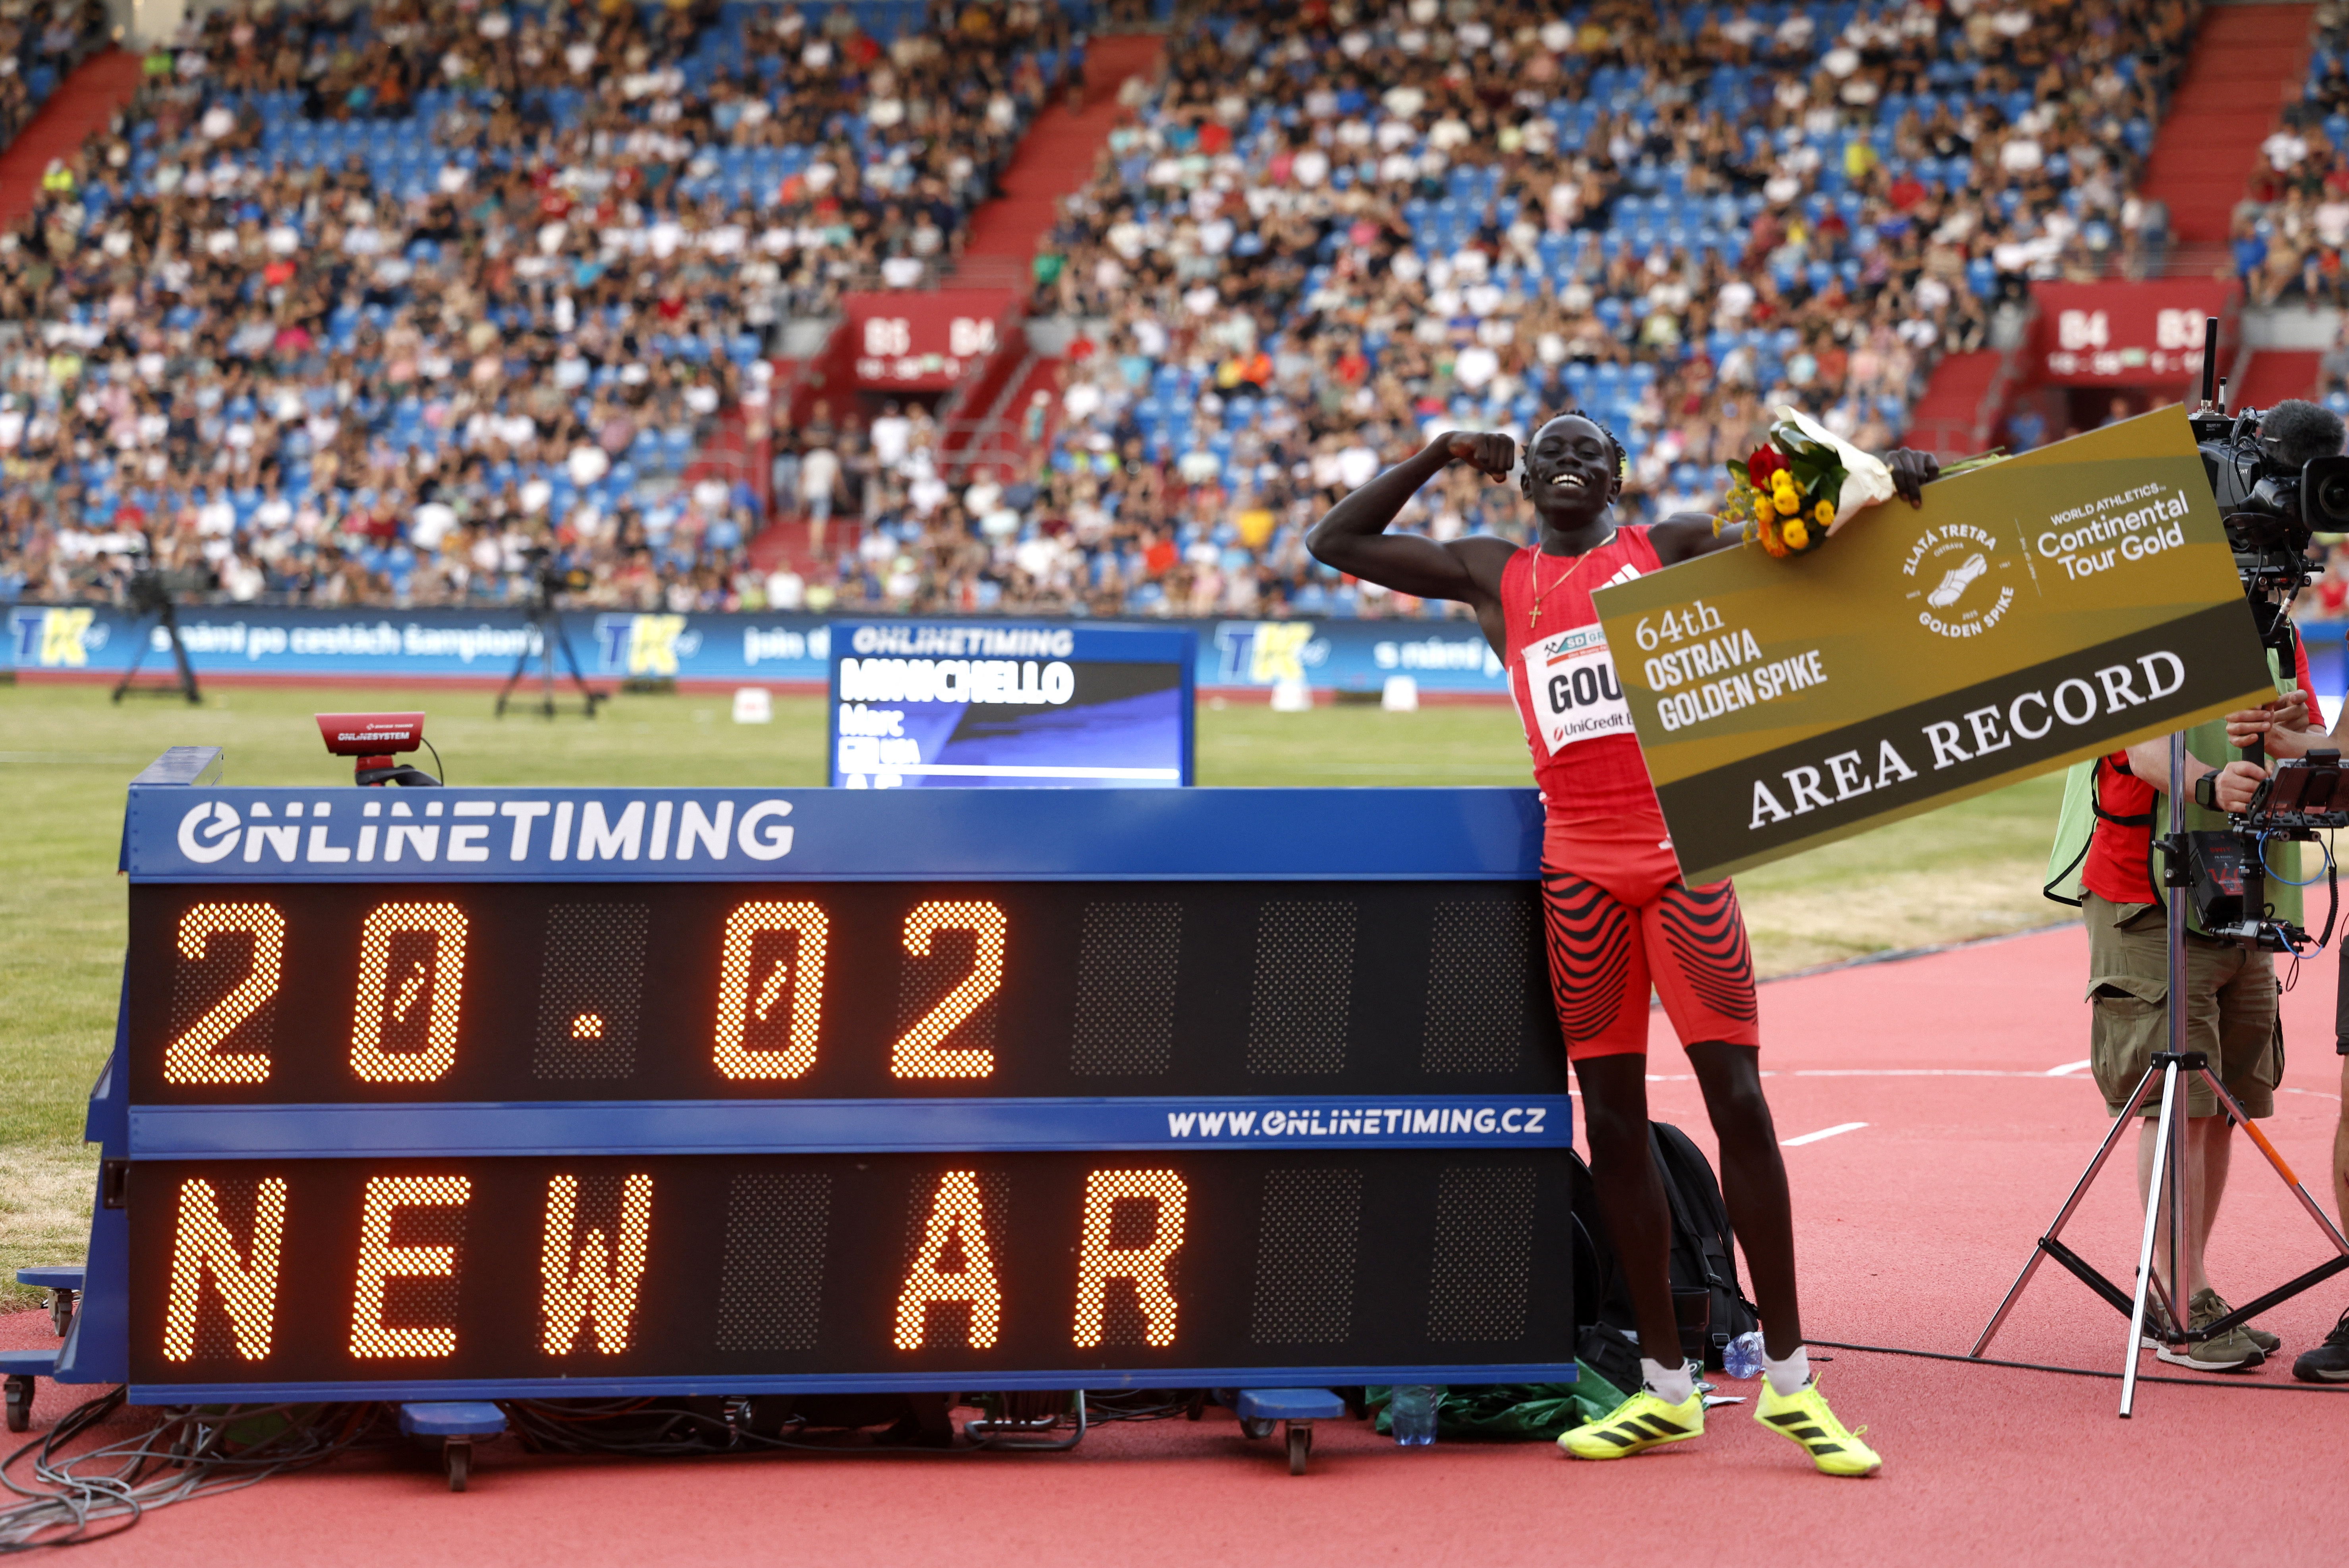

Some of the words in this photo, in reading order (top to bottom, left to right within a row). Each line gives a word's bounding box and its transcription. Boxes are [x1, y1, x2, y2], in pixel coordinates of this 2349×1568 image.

[2038, 489, 2189, 558] Continental
[2050, 504, 2094, 526] WORLD
[2096, 483, 2159, 512] ATHLETICS
[1903, 529, 1939, 576] ZLATÁ
[1939, 524, 1996, 551] TRETRA
[1934, 542, 1964, 557] OSTRAVA
[2057, 548, 2116, 580] Tour
[2121, 521, 2184, 561] Gold
[1636, 600, 1725, 651] 64th
[1919, 611, 1982, 637] GOLDEN
[1983, 586, 2014, 628] SPIKE
[852, 626, 1074, 657] ONLINETIMING
[1566, 635, 1585, 648] SD
[1644, 628, 1762, 691] OSTRAVA
[1657, 673, 1756, 731] GOLDEN
[1752, 649, 1827, 700] SPIKE
[338, 732, 410, 741] ONLINESYSTEM
[1565, 714, 1623, 736] UniCredit
[1748, 739, 1918, 830] AREA
[1922, 651, 2185, 770] RECORD
[178, 799, 794, 863] ONLINETIMING
[163, 902, 1007, 1084] 20.02
[1168, 1108, 1546, 1137] WWW.ONLINETIMING.CZ
[162, 1173, 653, 1361] NEW
[894, 1169, 1188, 1350] AR
